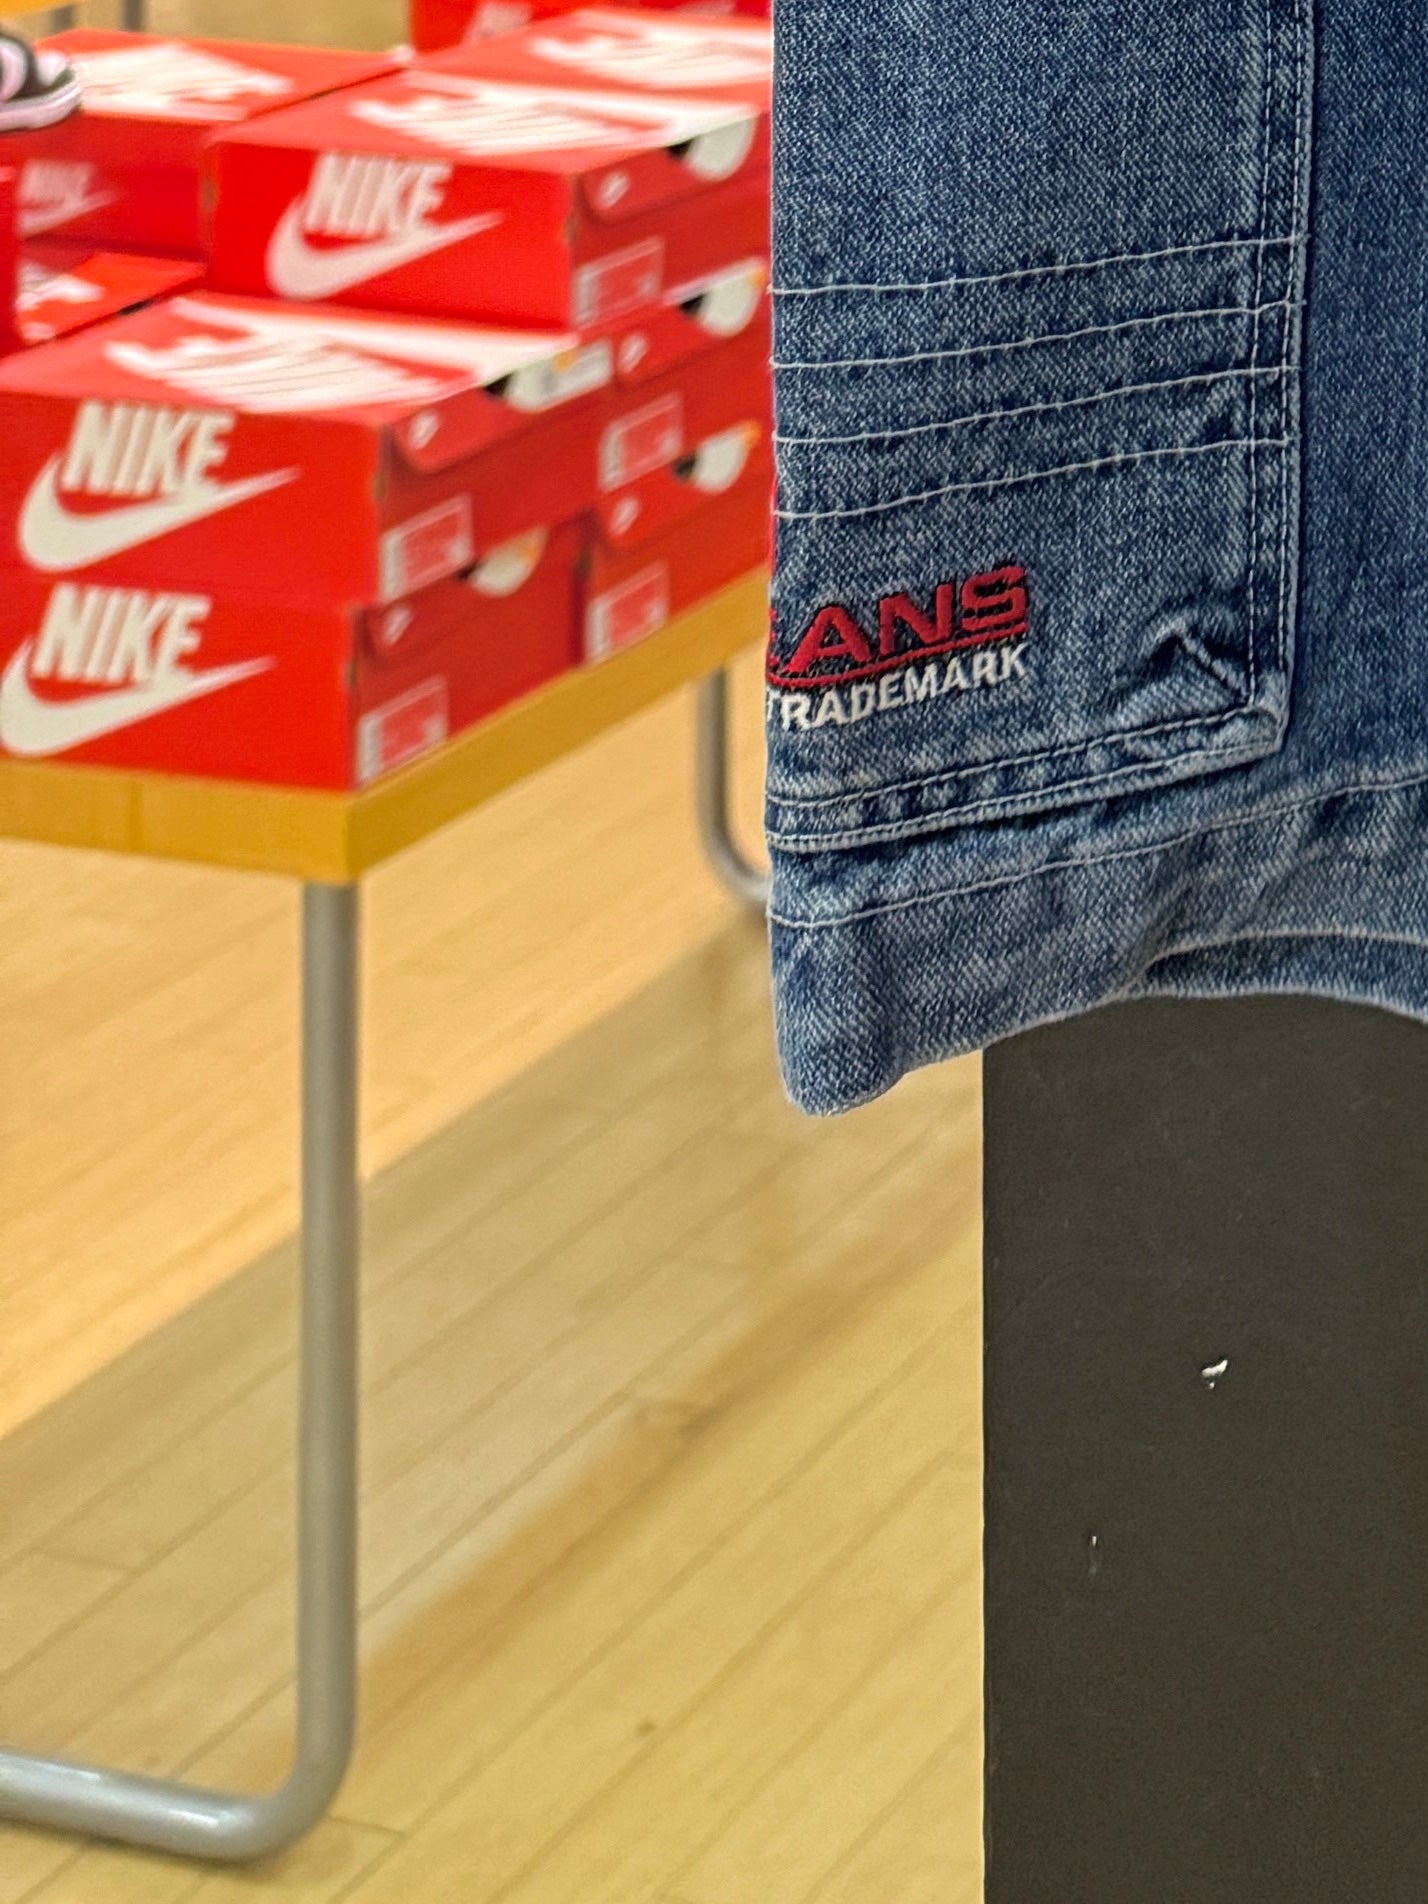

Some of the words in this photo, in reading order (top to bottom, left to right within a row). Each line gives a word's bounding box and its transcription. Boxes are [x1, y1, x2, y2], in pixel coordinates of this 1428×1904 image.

[304, 151, 455, 235] NIKE
[61, 398, 237, 496] NIKE
[31, 582, 212, 683] NIKE
[769, 566, 1027, 672] ANS
